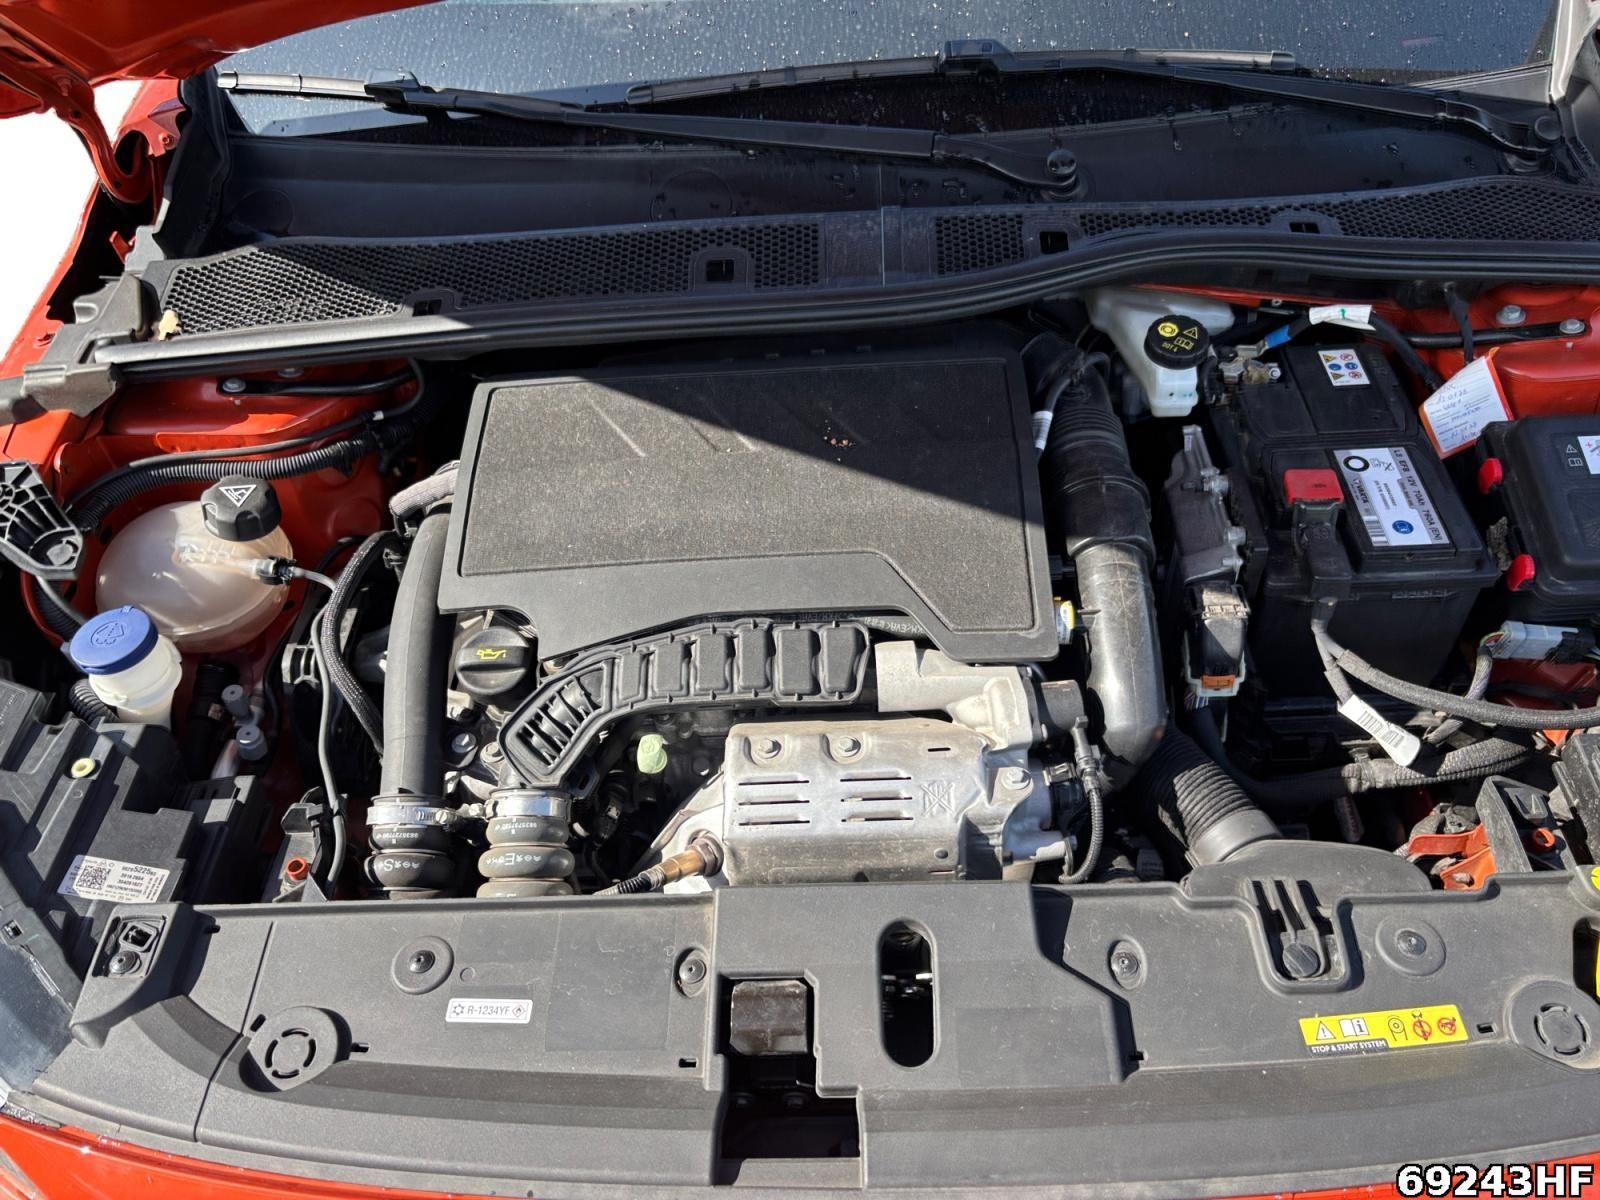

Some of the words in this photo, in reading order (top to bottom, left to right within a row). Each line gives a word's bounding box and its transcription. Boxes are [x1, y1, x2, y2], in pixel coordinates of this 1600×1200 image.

[1398, 460, 1410, 472] EFB
[1407, 475, 1417, 487] 12V
[1413, 490, 1425, 506] 70Ah
[1356, 485, 1369, 503] VARTA
[467, 1005, 511, 1016] R-1234YF
[1311, 1045, 1330, 1053] STOP
[1331, 1044, 1337, 1052] &
[1337, 1042, 1359, 1051] START
[1360, 1040, 1386, 1049] SYSTEM
